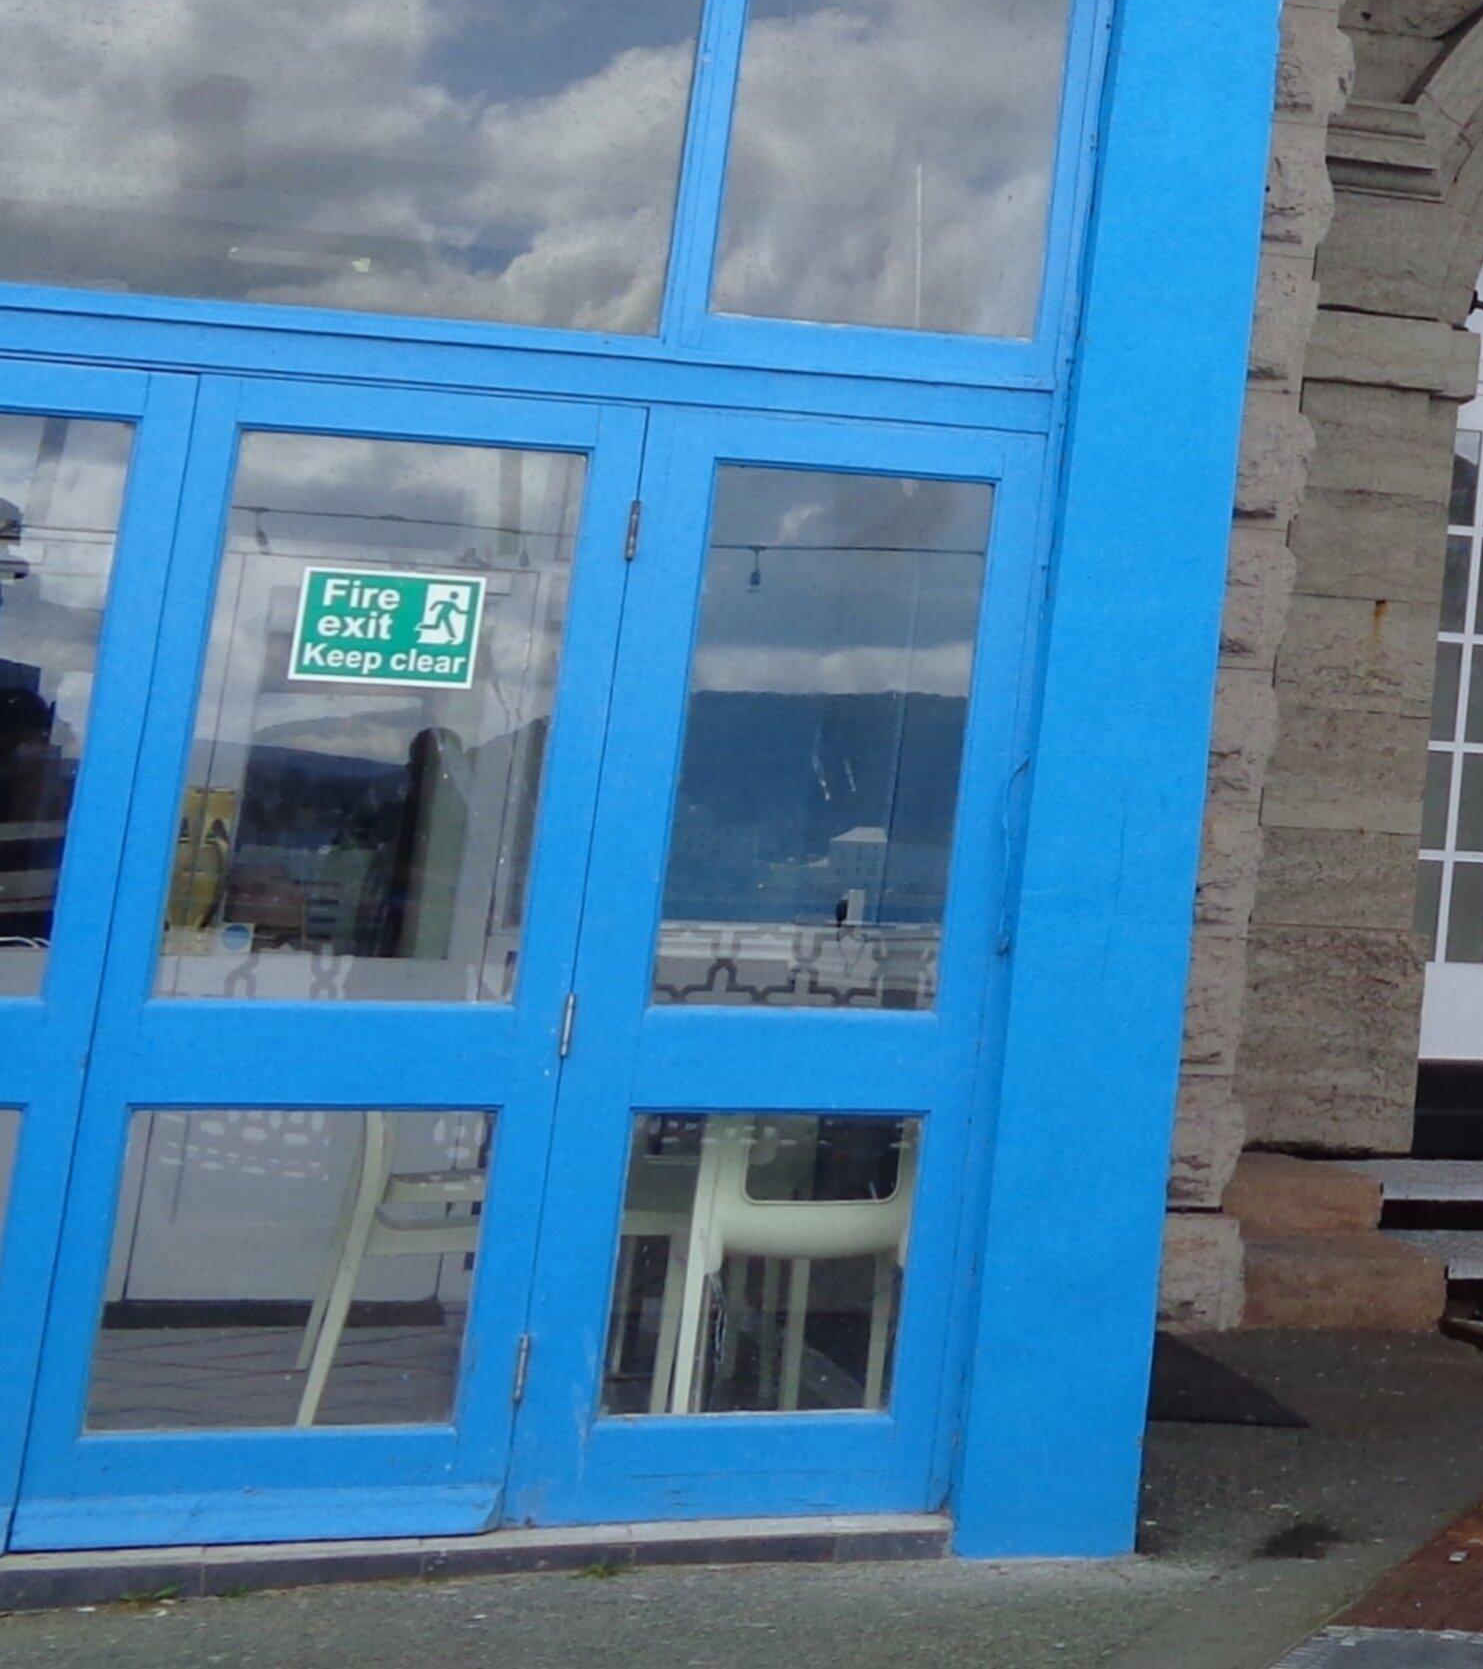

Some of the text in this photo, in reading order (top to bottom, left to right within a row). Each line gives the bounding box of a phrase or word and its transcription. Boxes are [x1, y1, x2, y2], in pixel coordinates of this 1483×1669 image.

[322, 578, 400, 610] Fire
[317, 612, 392, 640] exit
[302, 643, 466, 674] Keep clear
